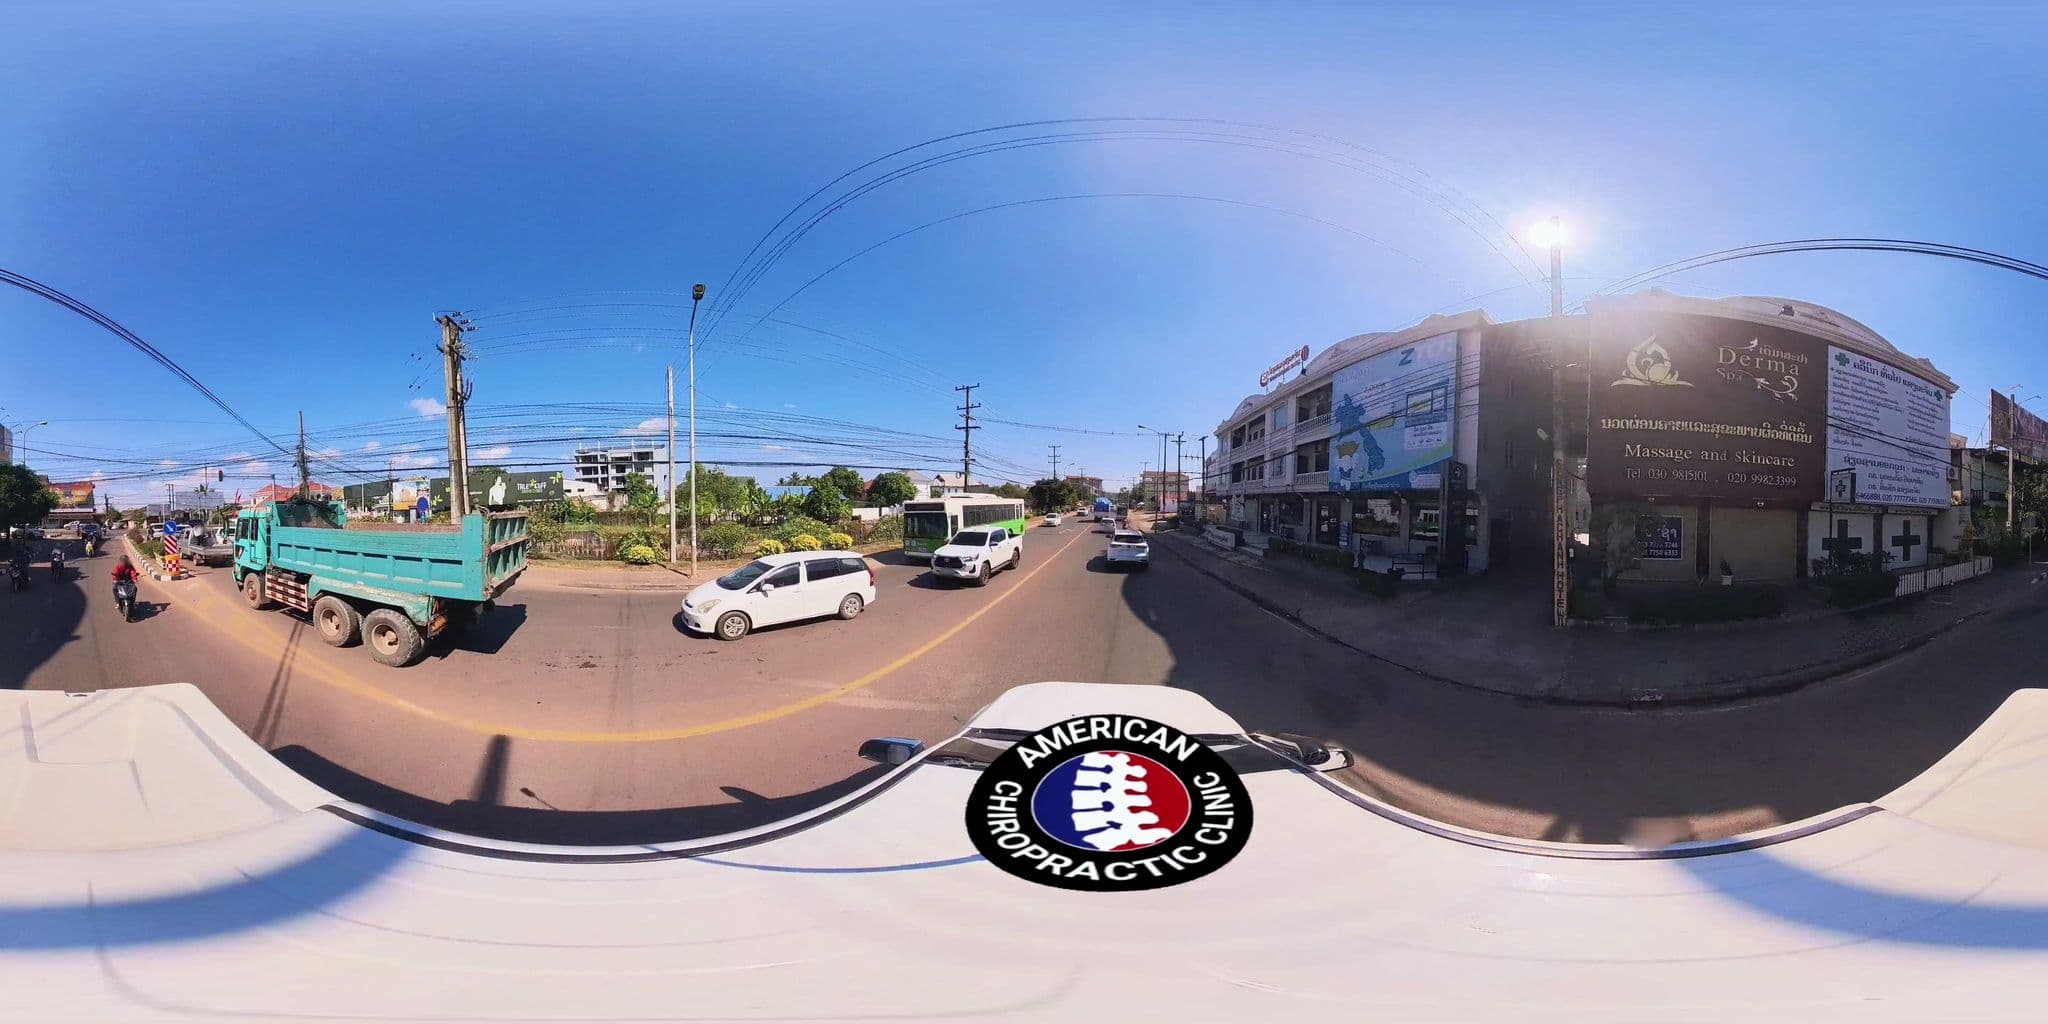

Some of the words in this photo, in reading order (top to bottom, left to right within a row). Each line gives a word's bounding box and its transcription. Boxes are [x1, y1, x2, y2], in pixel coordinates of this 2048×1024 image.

[1719, 347, 1799, 376] Derma
[1716, 367, 1742, 383] Spa
[1625, 443, 1692, 462] Massage
[1701, 450, 1727, 461] and
[1626, 467, 1641, 479] Tel
[1648, 468, 1667, 480] 030
[1727, 472, 1747, 483] 020
